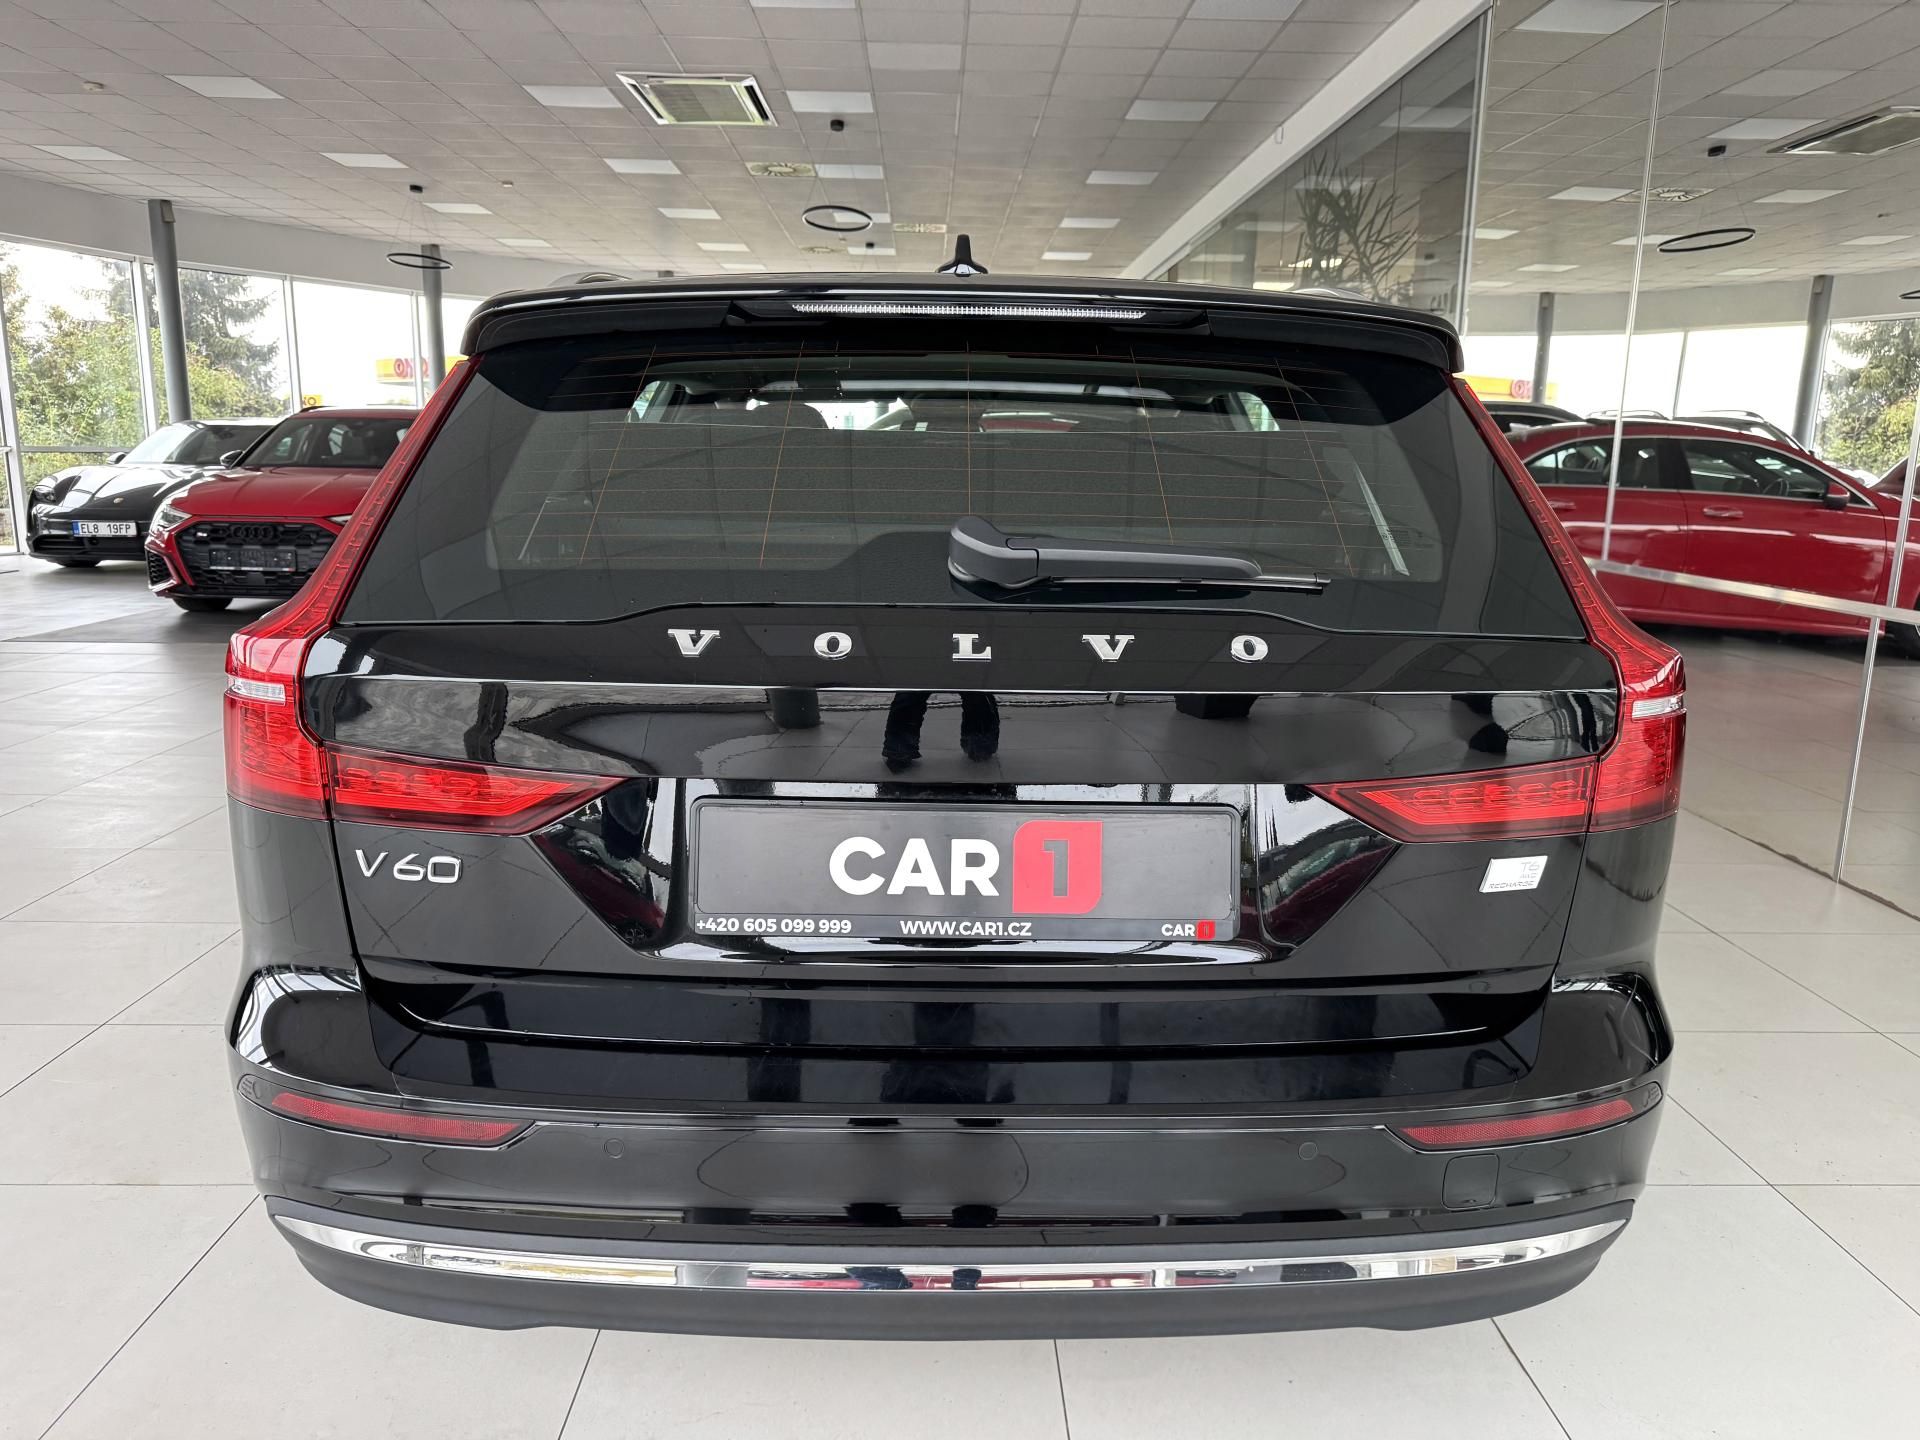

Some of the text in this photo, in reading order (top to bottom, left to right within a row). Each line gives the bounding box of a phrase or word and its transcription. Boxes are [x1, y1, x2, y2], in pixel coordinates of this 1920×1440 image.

[80, 523, 99, 534] EL8
[106, 523, 131, 534] 19FP
[667, 627, 1269, 662] VOLVO
[696, 917, 852, 933] +420 605 099 999
[900, 920, 1032, 936] WWW.CAR1.CZ
